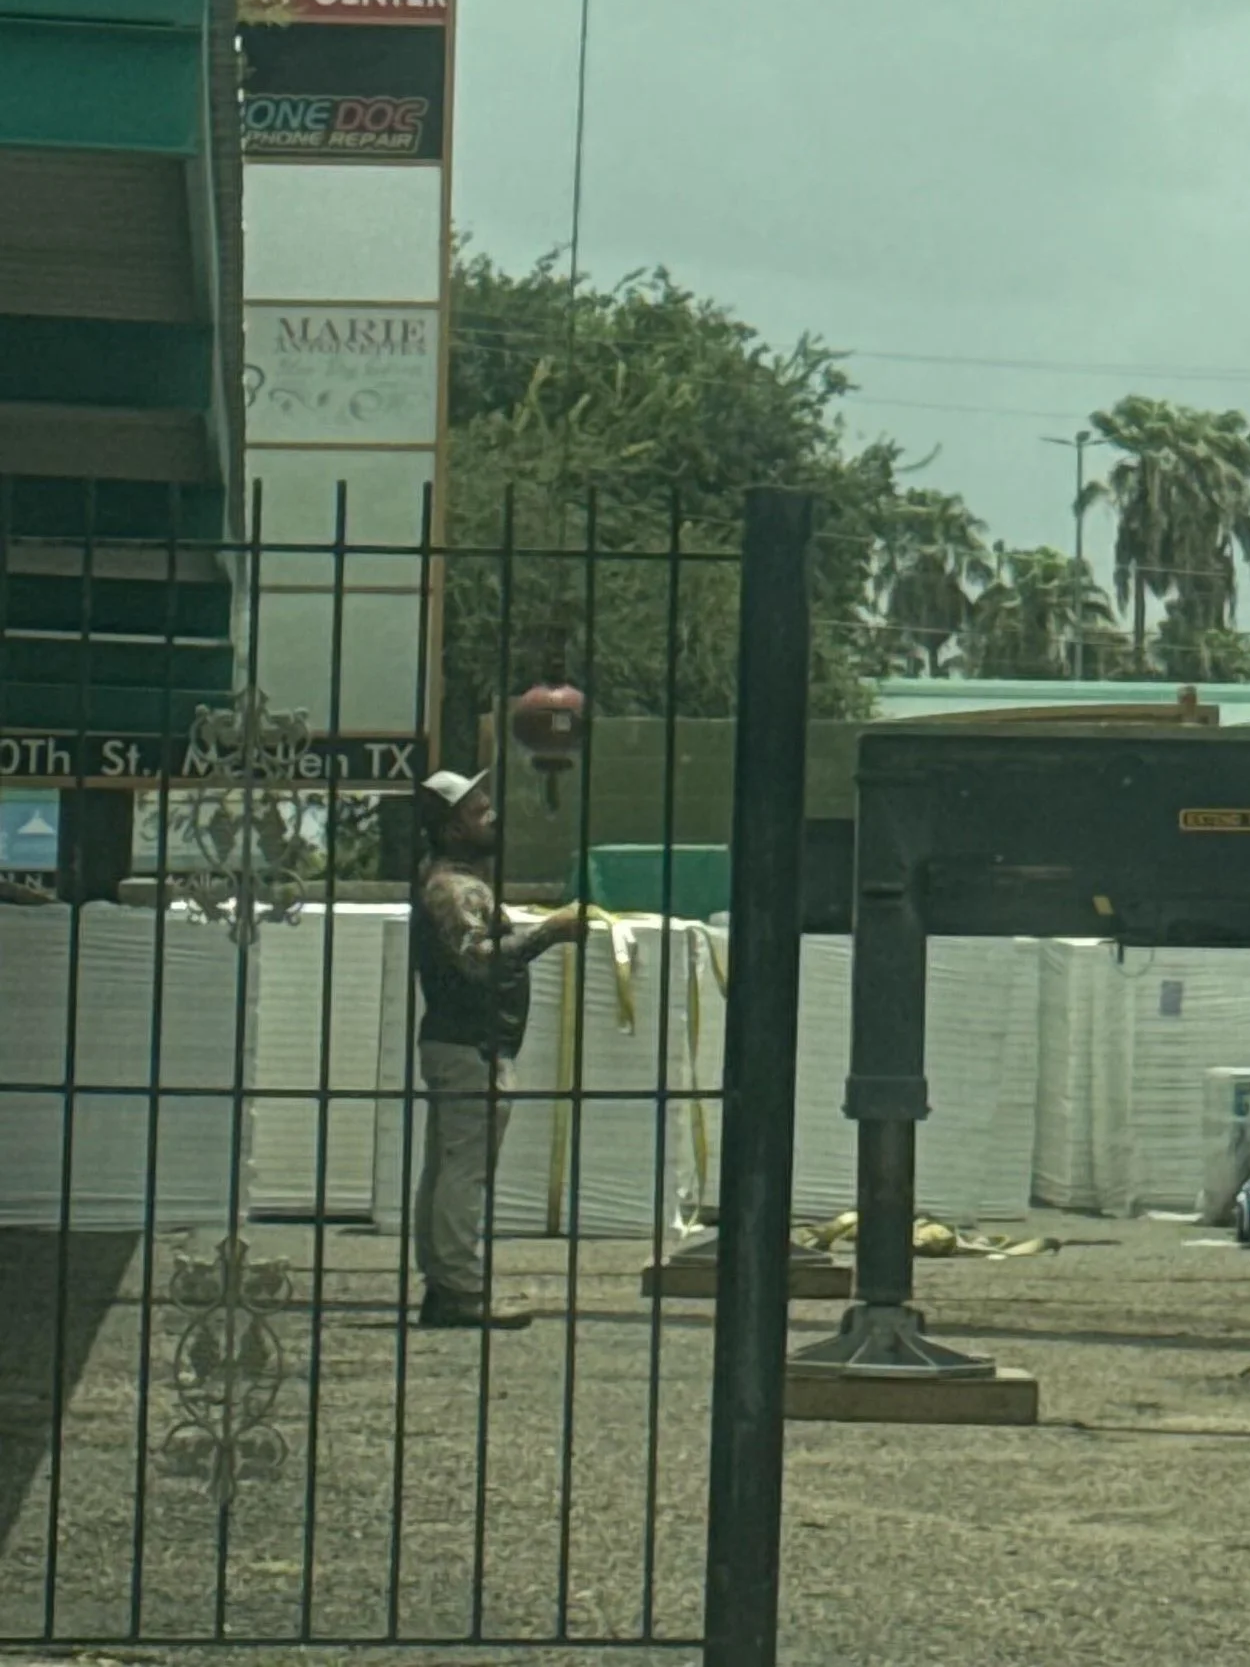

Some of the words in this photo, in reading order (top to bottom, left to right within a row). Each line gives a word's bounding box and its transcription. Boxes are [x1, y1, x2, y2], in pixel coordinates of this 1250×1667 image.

[328, 133, 413, 148] REPAIR
[279, 317, 426, 343] MARIE
[365, 743, 416, 779] TX
